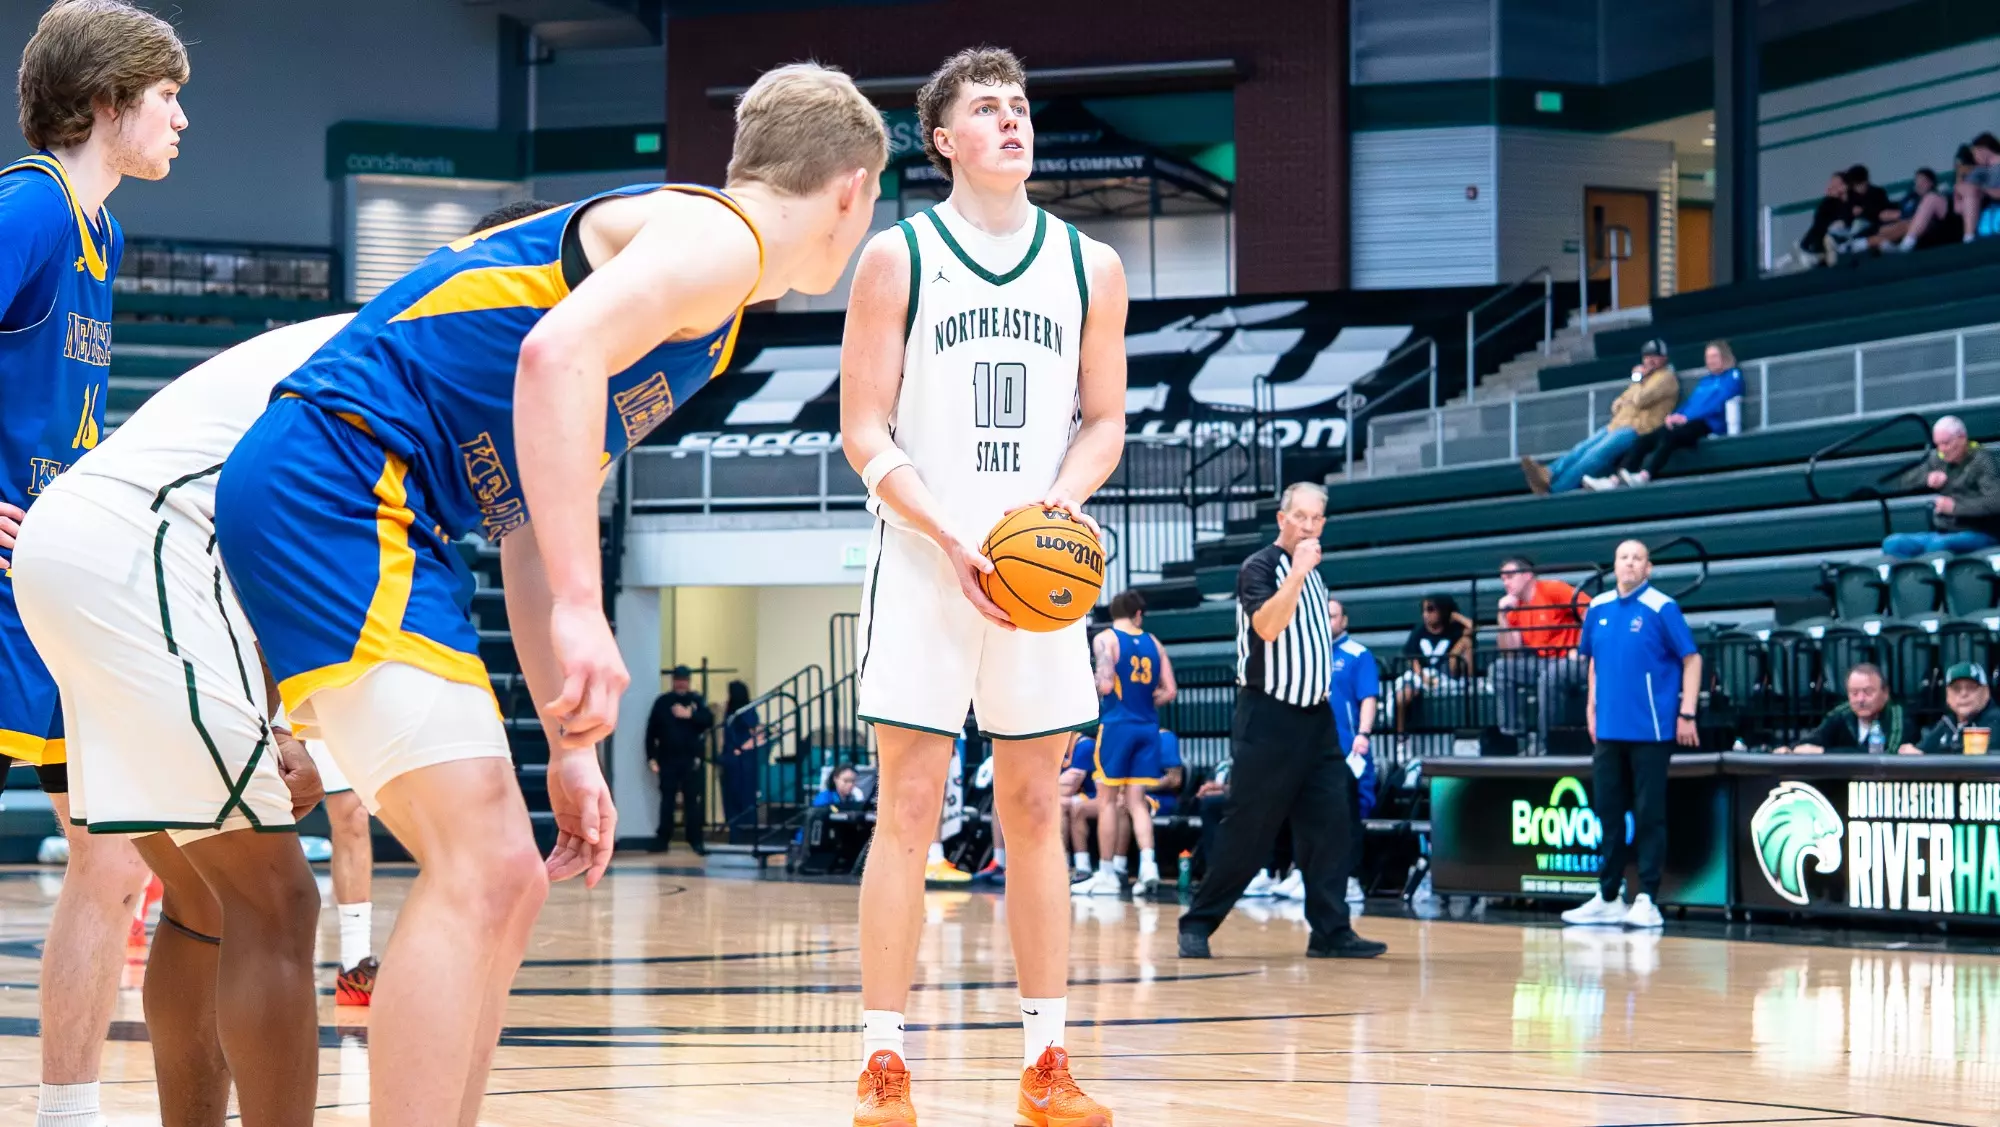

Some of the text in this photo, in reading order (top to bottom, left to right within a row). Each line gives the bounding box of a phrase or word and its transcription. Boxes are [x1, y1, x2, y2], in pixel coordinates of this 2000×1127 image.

[1069, 156, 1146, 172] COMPANY
[934, 307, 1063, 357] NORTHEASTERN
[973, 362, 1026, 428] 10
[72, 383, 99, 450] 16
[671, 430, 843, 458] Fede
[976, 441, 1020, 472] STATE
[459, 431, 525, 542] KEAR
[1035, 535, 1104, 577] Wilson
[1130, 655, 1152, 684] 23
[1848, 781, 1955, 819] NORTHEASTERN
[1848, 821, 2000, 915] RIVERHA
